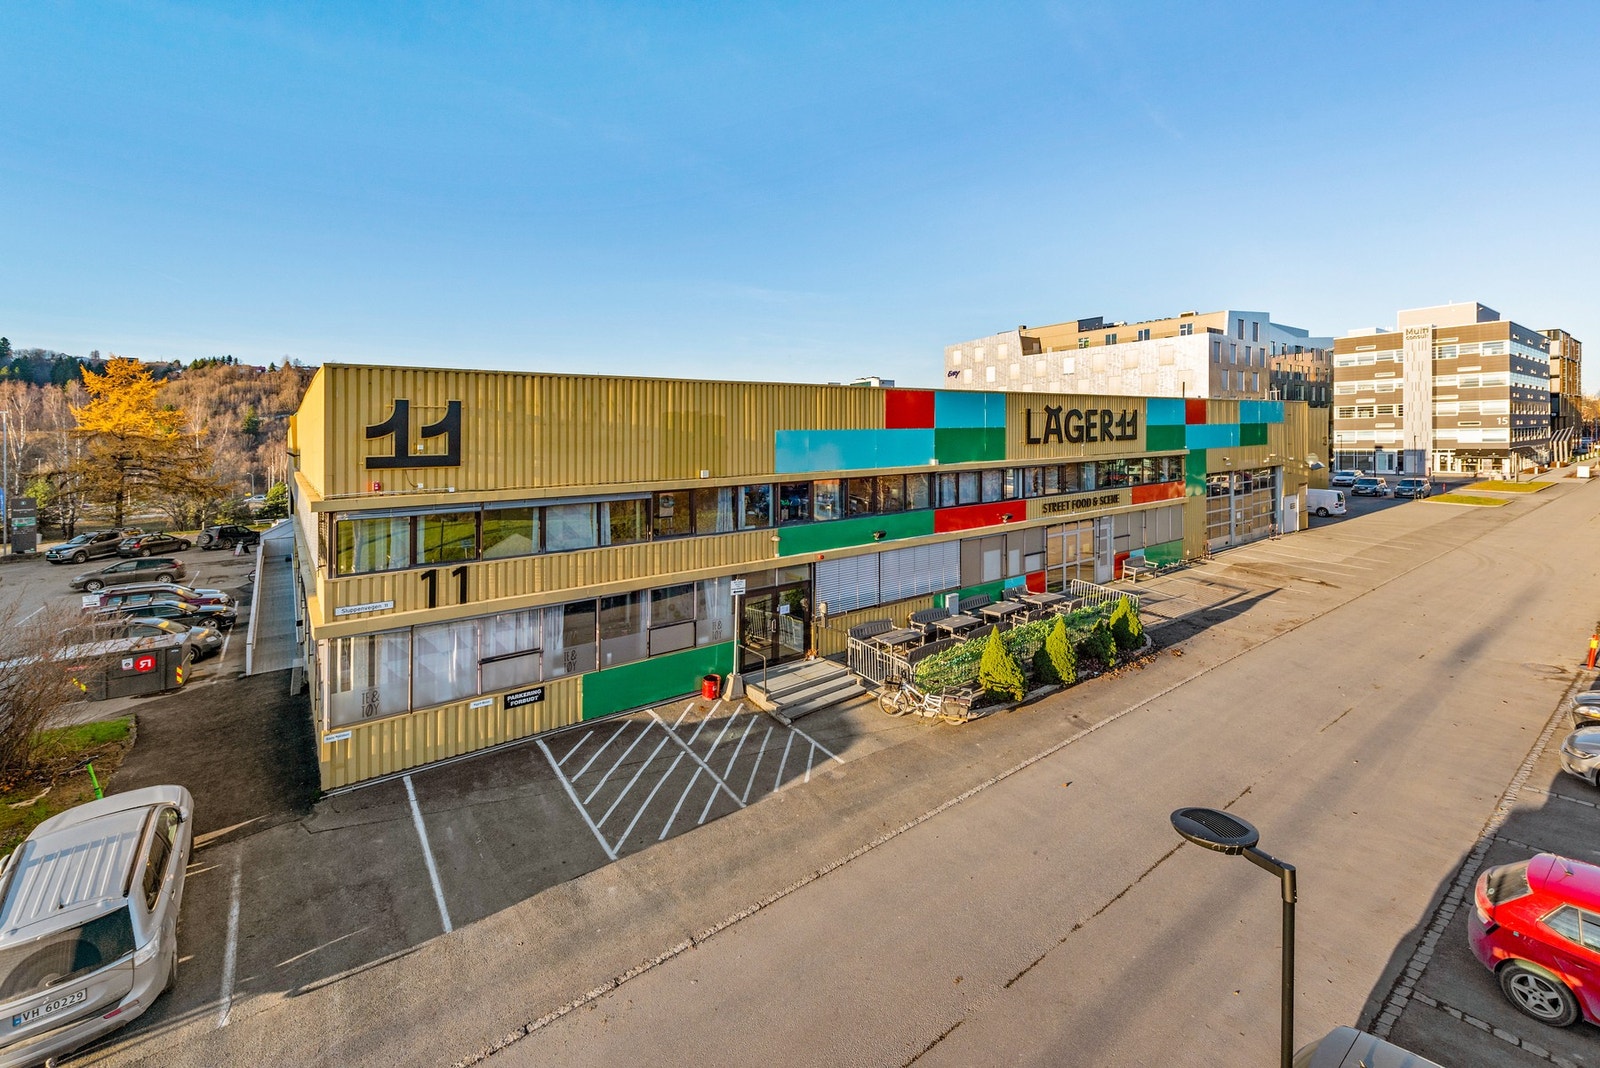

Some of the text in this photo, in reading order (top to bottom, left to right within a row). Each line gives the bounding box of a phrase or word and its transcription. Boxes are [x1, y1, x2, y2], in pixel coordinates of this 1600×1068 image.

[1497, 417, 1509, 425] 15
[366, 400, 461, 469] 11
[1043, 494, 1120, 514] STREET FOOD & SCENE
[421, 566, 467, 608] 11
[341, 604, 382, 614] Sluppenvegen
[507, 688, 542, 701] PARKERING
[510, 695, 539, 706] FORBUDT
[23, 992, 83, 1020] VH 60229
